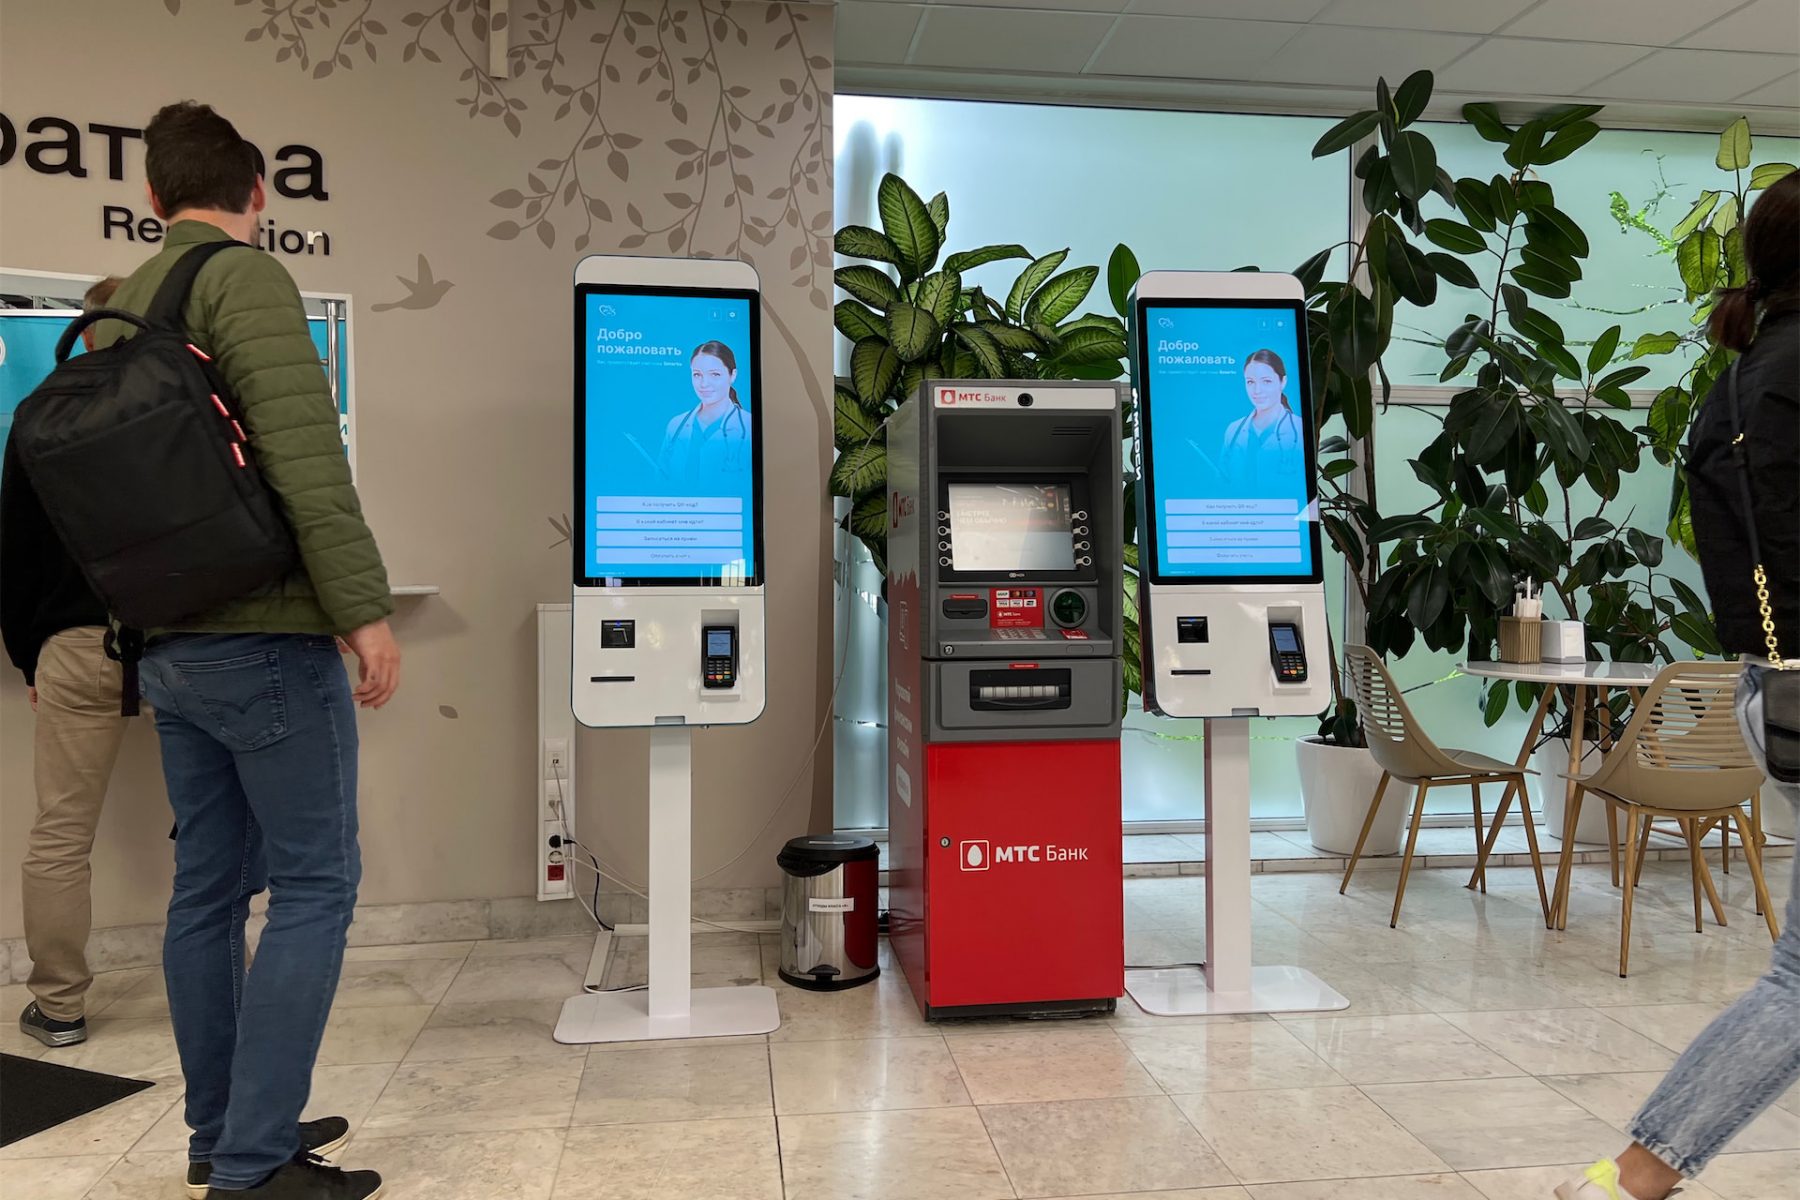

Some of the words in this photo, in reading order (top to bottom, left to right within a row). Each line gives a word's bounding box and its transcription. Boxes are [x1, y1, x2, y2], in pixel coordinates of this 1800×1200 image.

[597, 328, 642, 341] Добро
[597, 344, 682, 356] пожаловать
[1158, 340, 1199, 352] Добро
[1158, 355, 1236, 365] пожаловать
[959, 393, 981, 401] МТС
[984, 393, 1007, 402] Банк
[995, 845, 1040, 863] МТС
[1046, 844, 1089, 862] Банк
